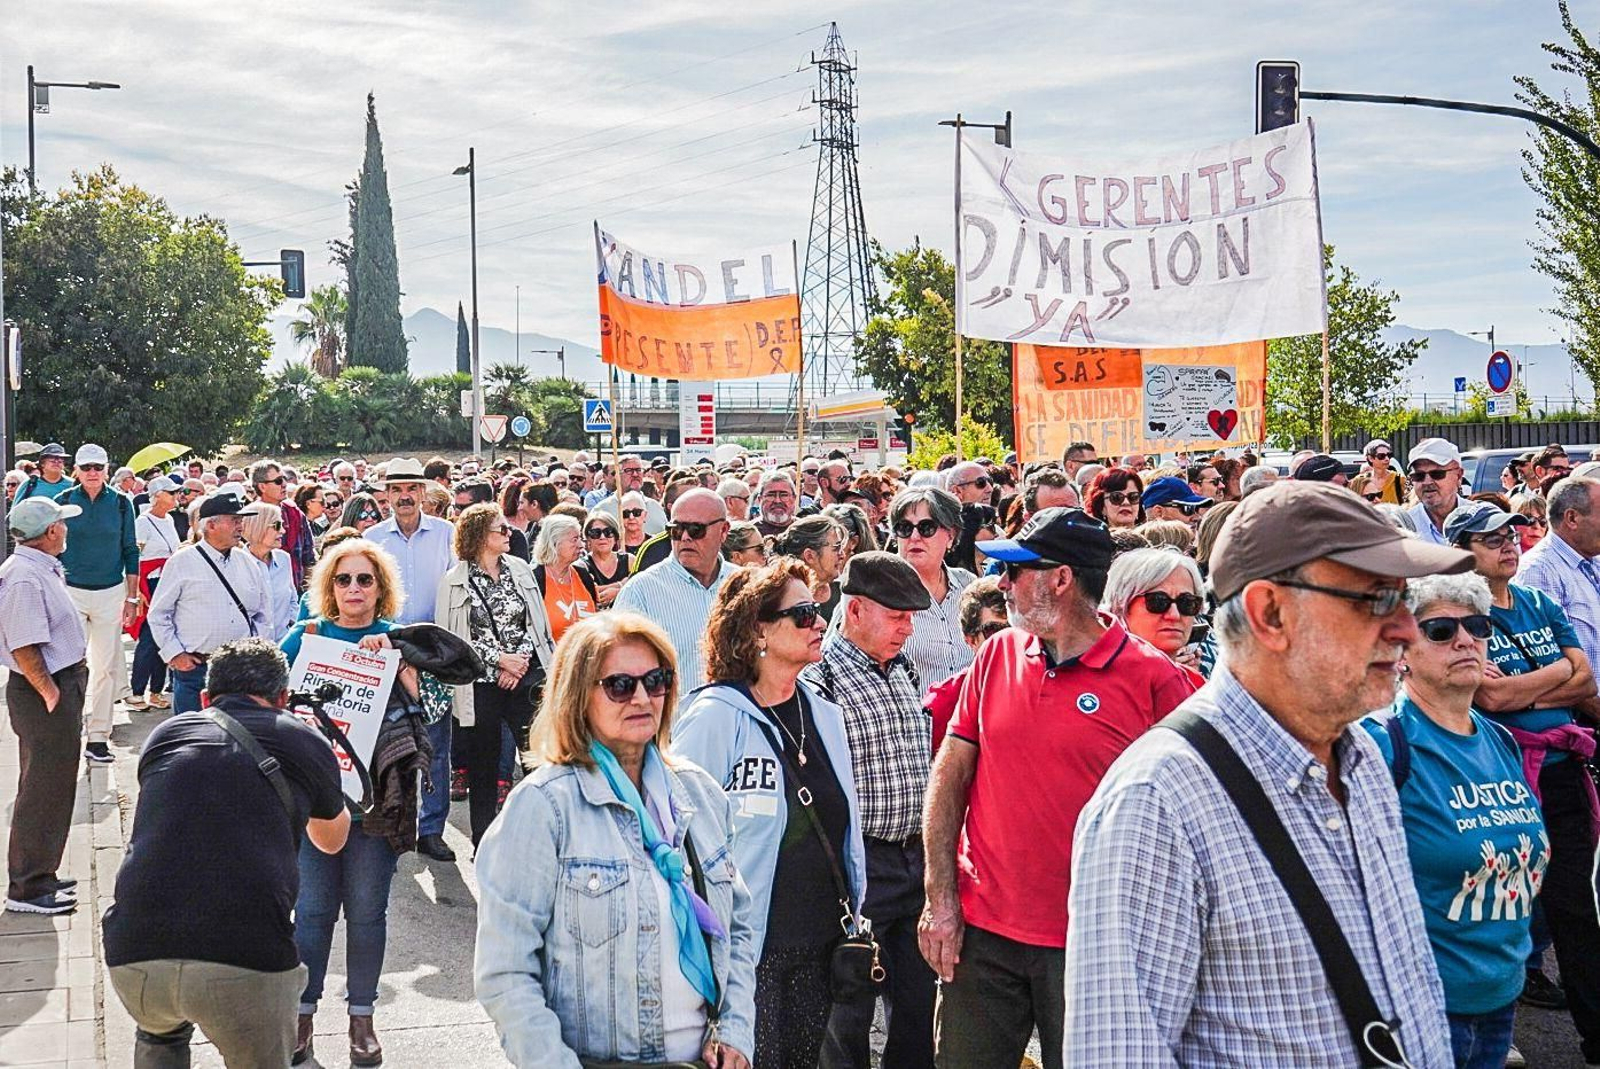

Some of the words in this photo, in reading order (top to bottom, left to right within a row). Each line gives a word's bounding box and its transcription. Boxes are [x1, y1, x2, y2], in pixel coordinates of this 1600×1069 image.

[1037, 145, 1287, 228] GERENTES
[1053, 388, 1138, 422] SANIDAD
[1025, 422, 1048, 456] SE
[354, 656, 385, 670] Octubre
[1493, 654, 1510, 664] por
[1510, 651, 1520, 660] la
[308, 663, 327, 674] Gran
[327, 666, 379, 686] Concentración
[356, 685, 375, 700] de
[1456, 818, 1478, 834] por
[1477, 813, 1492, 828] la
